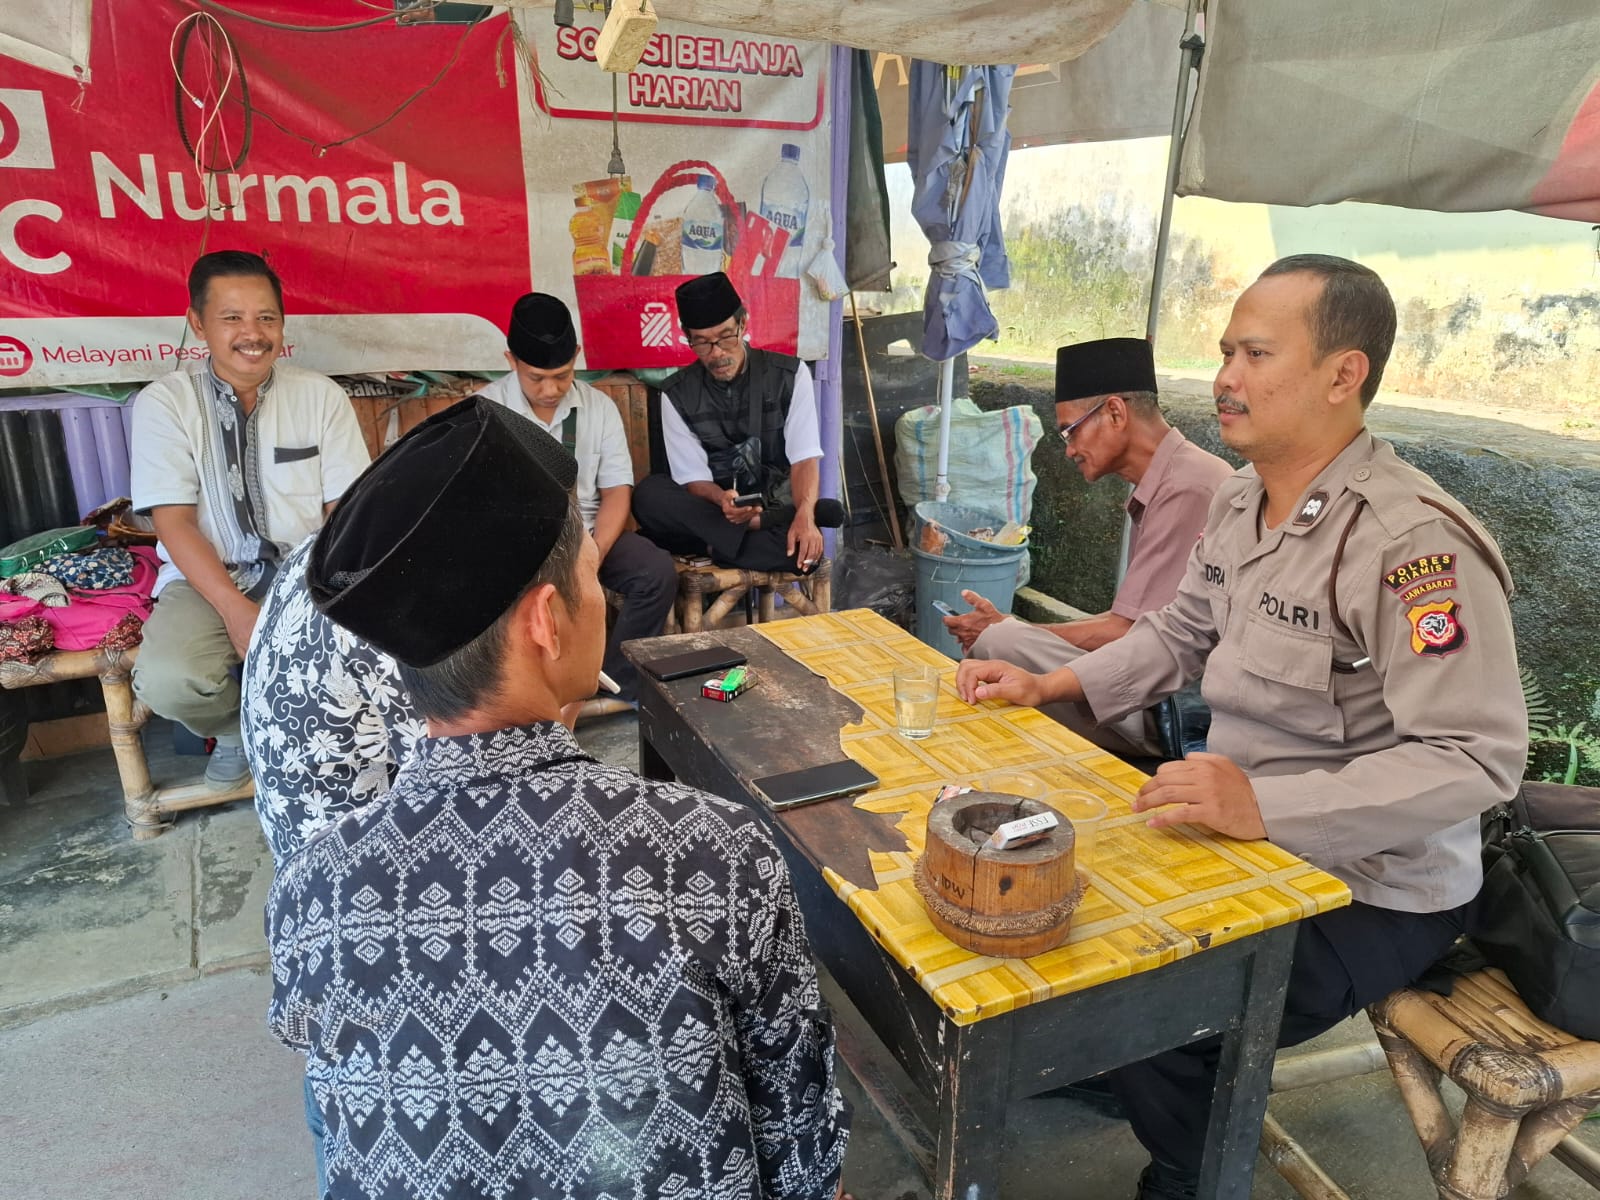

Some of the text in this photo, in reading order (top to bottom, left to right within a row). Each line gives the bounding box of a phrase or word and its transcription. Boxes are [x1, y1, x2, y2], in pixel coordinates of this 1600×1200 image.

[557, 26, 802, 76] SOSI BELANJA
[629, 73, 741, 111] HARIAN
[90, 151, 464, 226] Nurmala
[688, 224, 716, 239] AQUA
[766, 209, 798, 230] AQUA
[42, 343, 152, 367] Melayani
[1387, 555, 1450, 584] POLRES
[1399, 564, 1442, 584] CIAMIS
[1404, 579, 1453, 601] JAWA BARAT
[1258, 592, 1319, 630] POLRI
